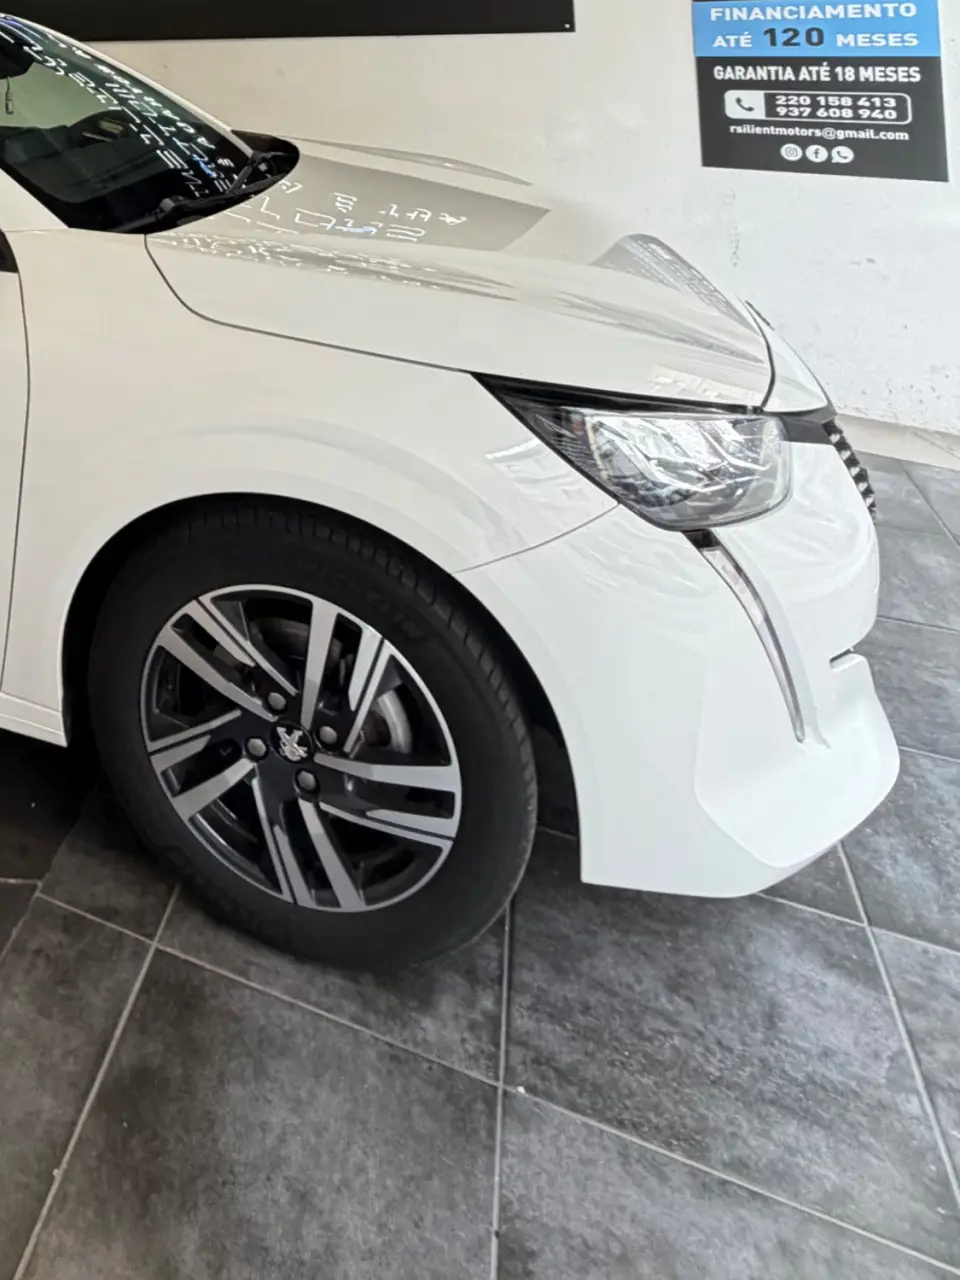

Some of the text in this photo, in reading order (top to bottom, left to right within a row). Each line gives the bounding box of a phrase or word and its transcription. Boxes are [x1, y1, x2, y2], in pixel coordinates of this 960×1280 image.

[710, 2, 918, 22] FINANCIAMENTO
[712, 27, 920, 48] ATÉ 120 MESES
[713, 61, 922, 83] GARANTIA ATÉ 18 MESES
[775, 95, 897, 108] 220 158 413
[775, 106, 898, 120] 937 608 940
[729, 124, 909, 141] rsilientmotors@gmail.com
